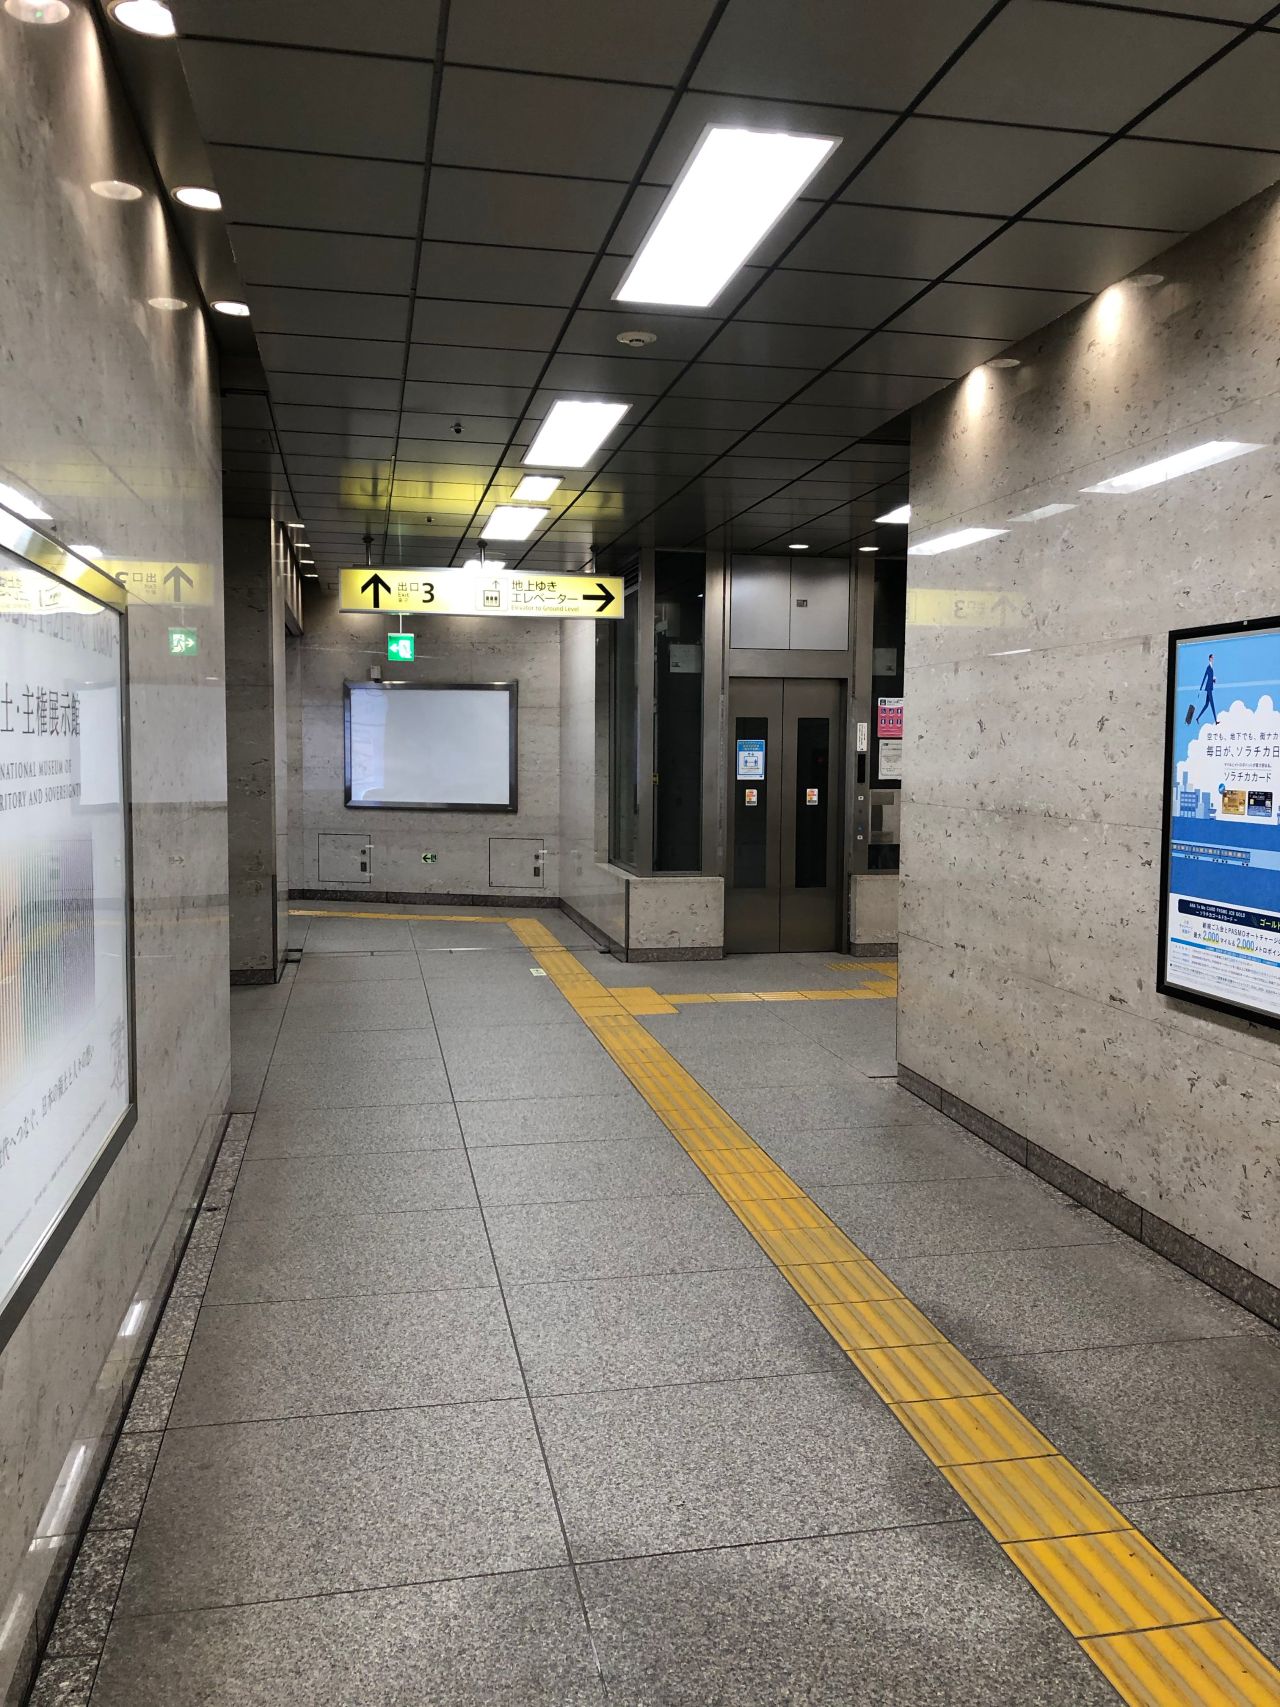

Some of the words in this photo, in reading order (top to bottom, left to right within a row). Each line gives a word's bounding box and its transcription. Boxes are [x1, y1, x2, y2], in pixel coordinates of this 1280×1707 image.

[397, 582, 419, 592] 出口
[422, 582, 435, 604] 3
[511, 579, 558, 593] 地上ゆき
[511, 592, 579, 605] エレベーター
[1207, 745, 1280, 758] 毎日が、ソラチカ日
[38, 759, 63, 777] MUSEUM
[65, 759, 72, 774] OF
[1224, 771, 1272, 783] ソラチカカード
[29, 788, 43, 806] AND
[1236, 937, 1254, 952] 2,000
